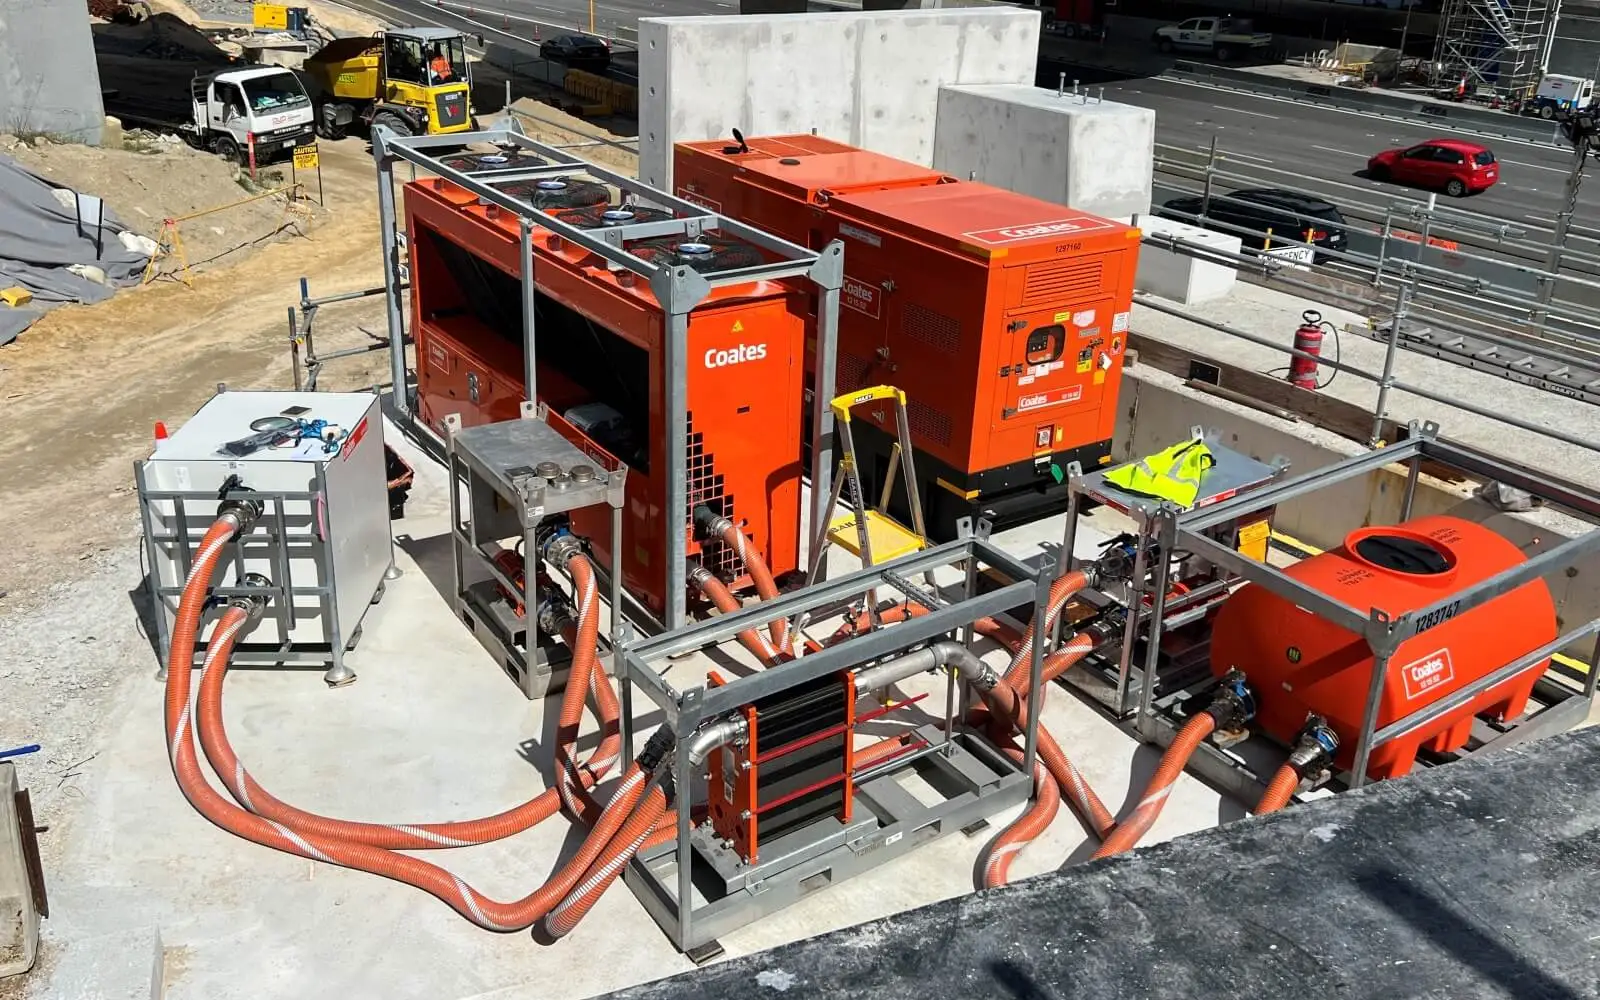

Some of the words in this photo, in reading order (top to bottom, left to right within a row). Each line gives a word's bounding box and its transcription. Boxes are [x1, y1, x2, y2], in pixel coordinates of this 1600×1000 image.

[293, 146, 317, 155] CAUTION
[1000, 222, 1081, 237] Coates
[1055, 243, 1082, 253] 1297160
[842, 280, 873, 302] Coates
[704, 343, 767, 369] Coates
[1021, 394, 1048, 408] Coates
[1415, 599, 1461, 634] 1283747
[1411, 658, 1444, 682] Coates
